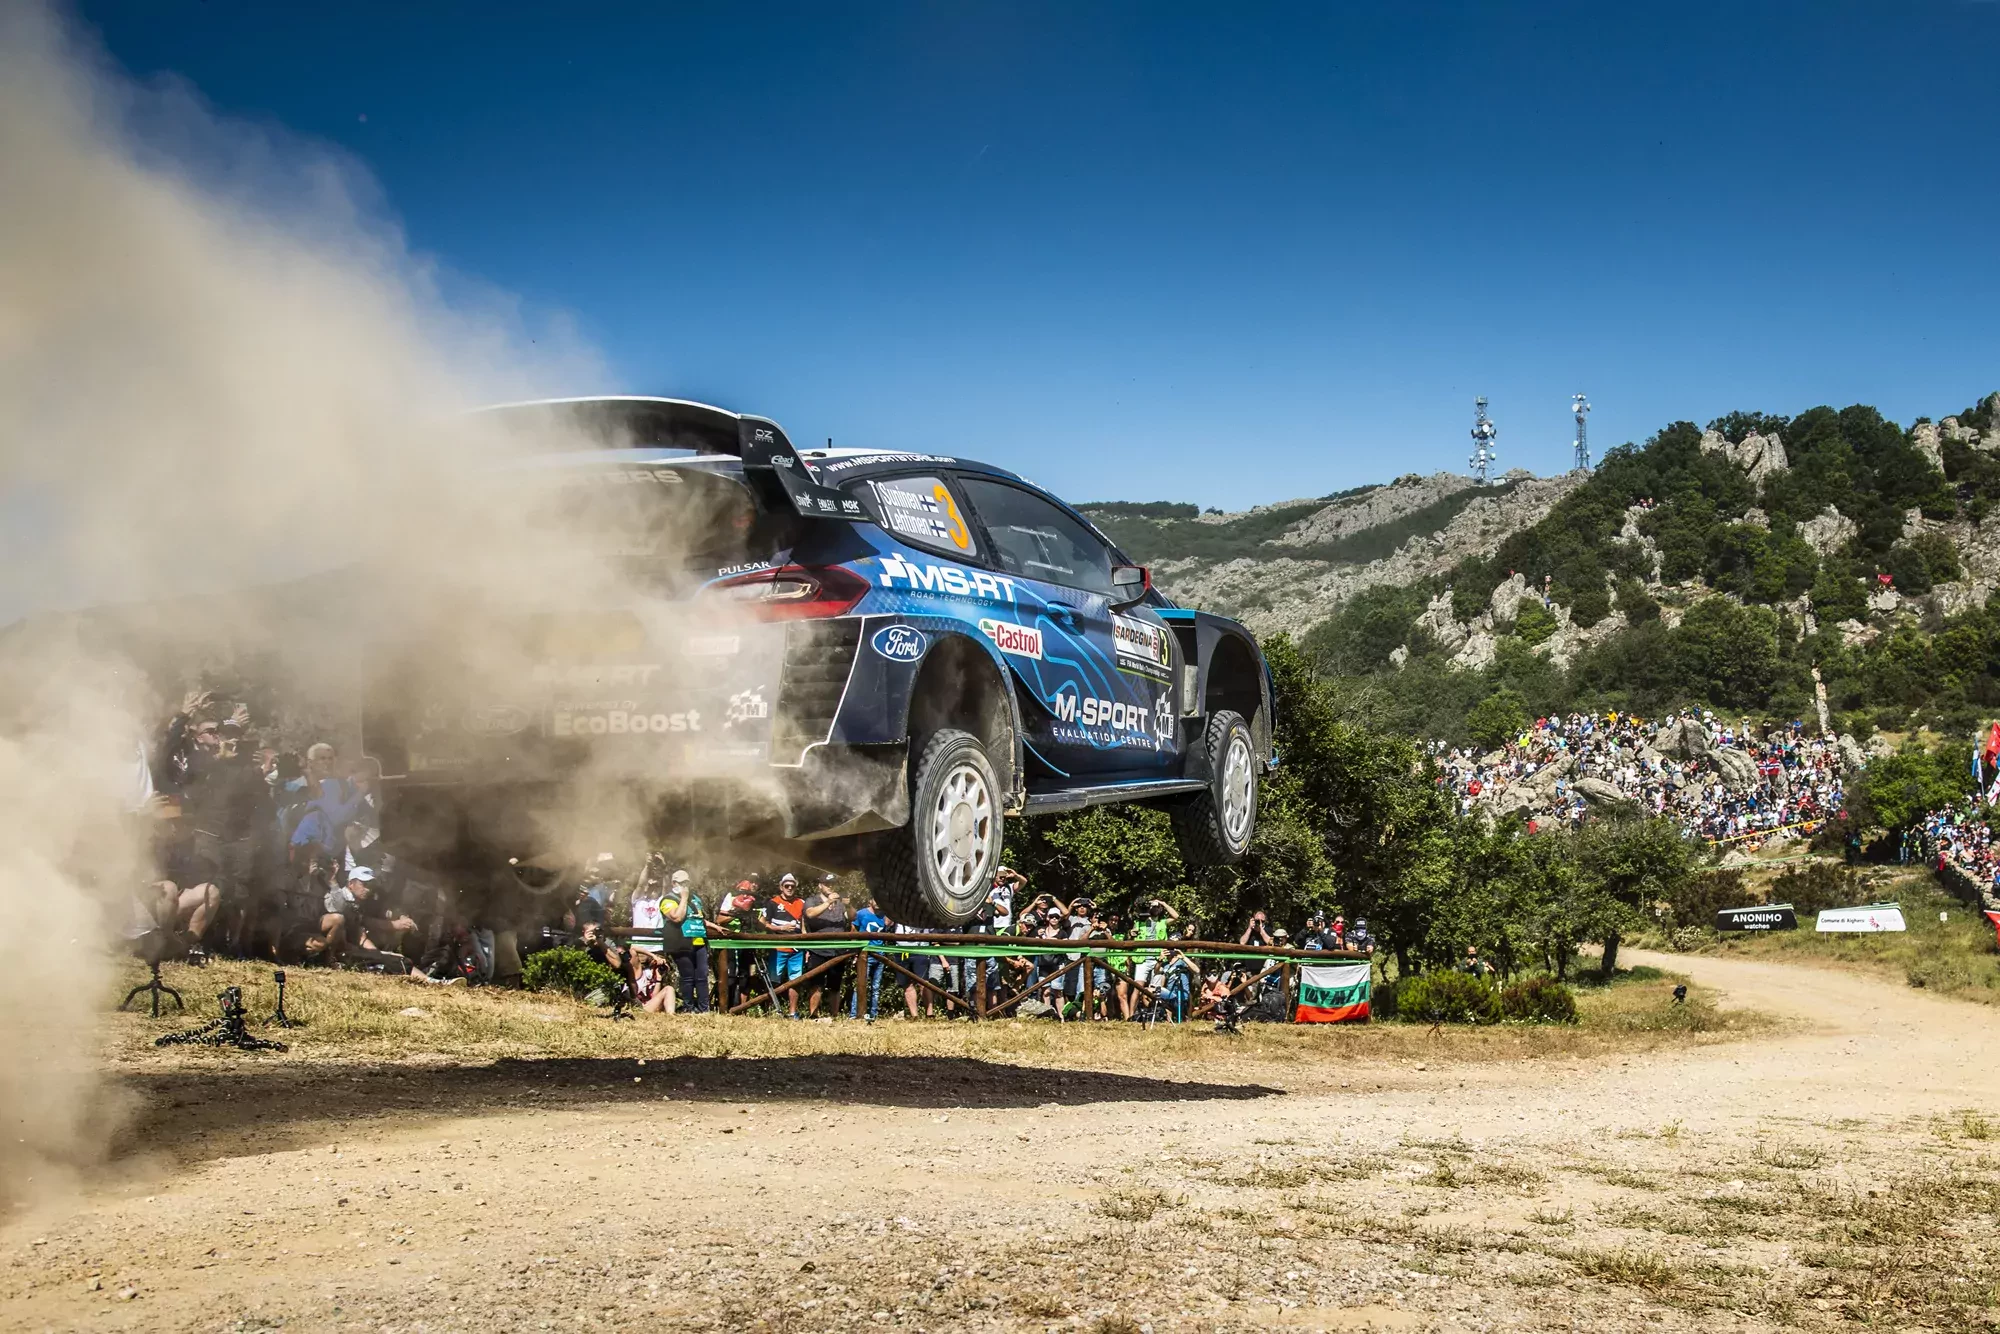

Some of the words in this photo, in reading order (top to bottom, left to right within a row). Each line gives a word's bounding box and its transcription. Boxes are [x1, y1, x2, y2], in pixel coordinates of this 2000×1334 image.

[755, 429, 774, 439] OZ
[842, 500, 859, 510] NGK
[867, 480, 881, 504] T
[877, 481, 922, 511] Suninen
[878, 505, 889, 529] J
[885, 506, 931, 536] Lehtinen
[933, 484, 969, 549] 3
[718, 561, 771, 576] PULSAR
[903, 562, 1015, 603] MS-RT
[911, 591, 935, 600] ROAD
[939, 593, 995, 607] TECHNOLOGY
[885, 628, 920, 657] Ford
[996, 624, 1040, 655] Castrol
[1115, 625, 1152, 648] SARDEGNA
[1159, 629, 1168, 666] 3
[553, 708, 701, 736] EcoBoost
[1054, 693, 1149, 734] M-SPORT
[1053, 727, 1117, 743] EVALUATION
[1120, 736, 1151, 748] CENTRE
[1732, 913, 1782, 922] ANONIMO
